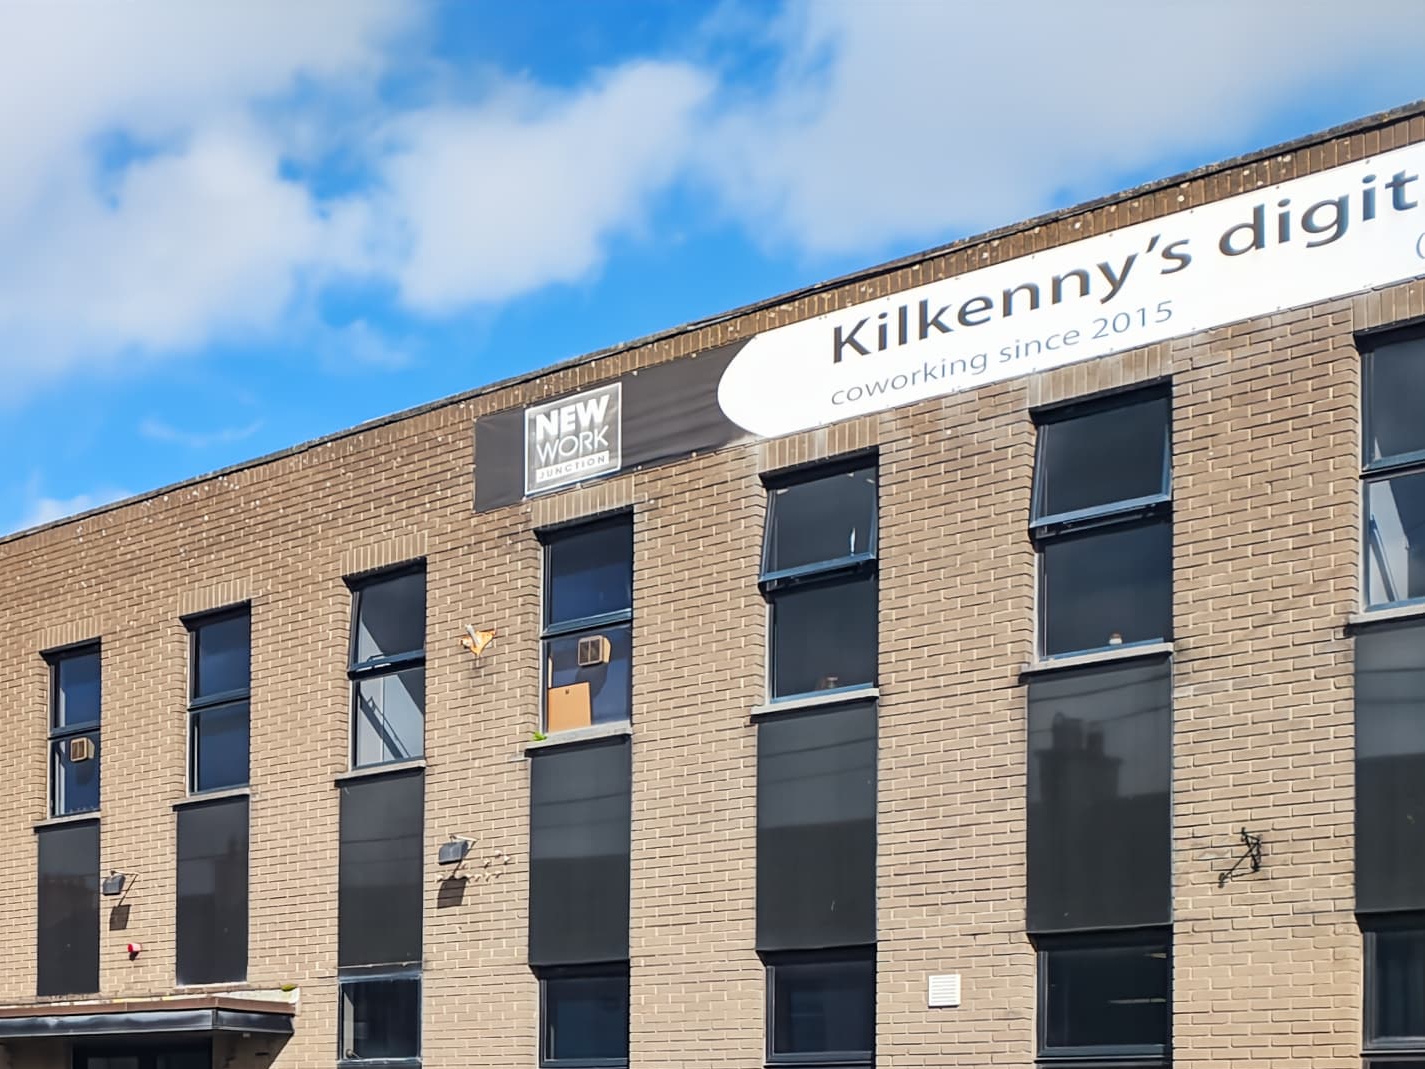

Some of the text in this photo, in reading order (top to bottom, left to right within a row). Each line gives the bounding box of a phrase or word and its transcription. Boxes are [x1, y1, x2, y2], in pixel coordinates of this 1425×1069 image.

[833, 169, 1419, 364] Kilkenny's digit
[831, 300, 1173, 406] coworking since 2015
[535, 394, 610, 442] NEW
[536, 425, 609, 466] WORK
[539, 455, 605, 480] JUNCTION
